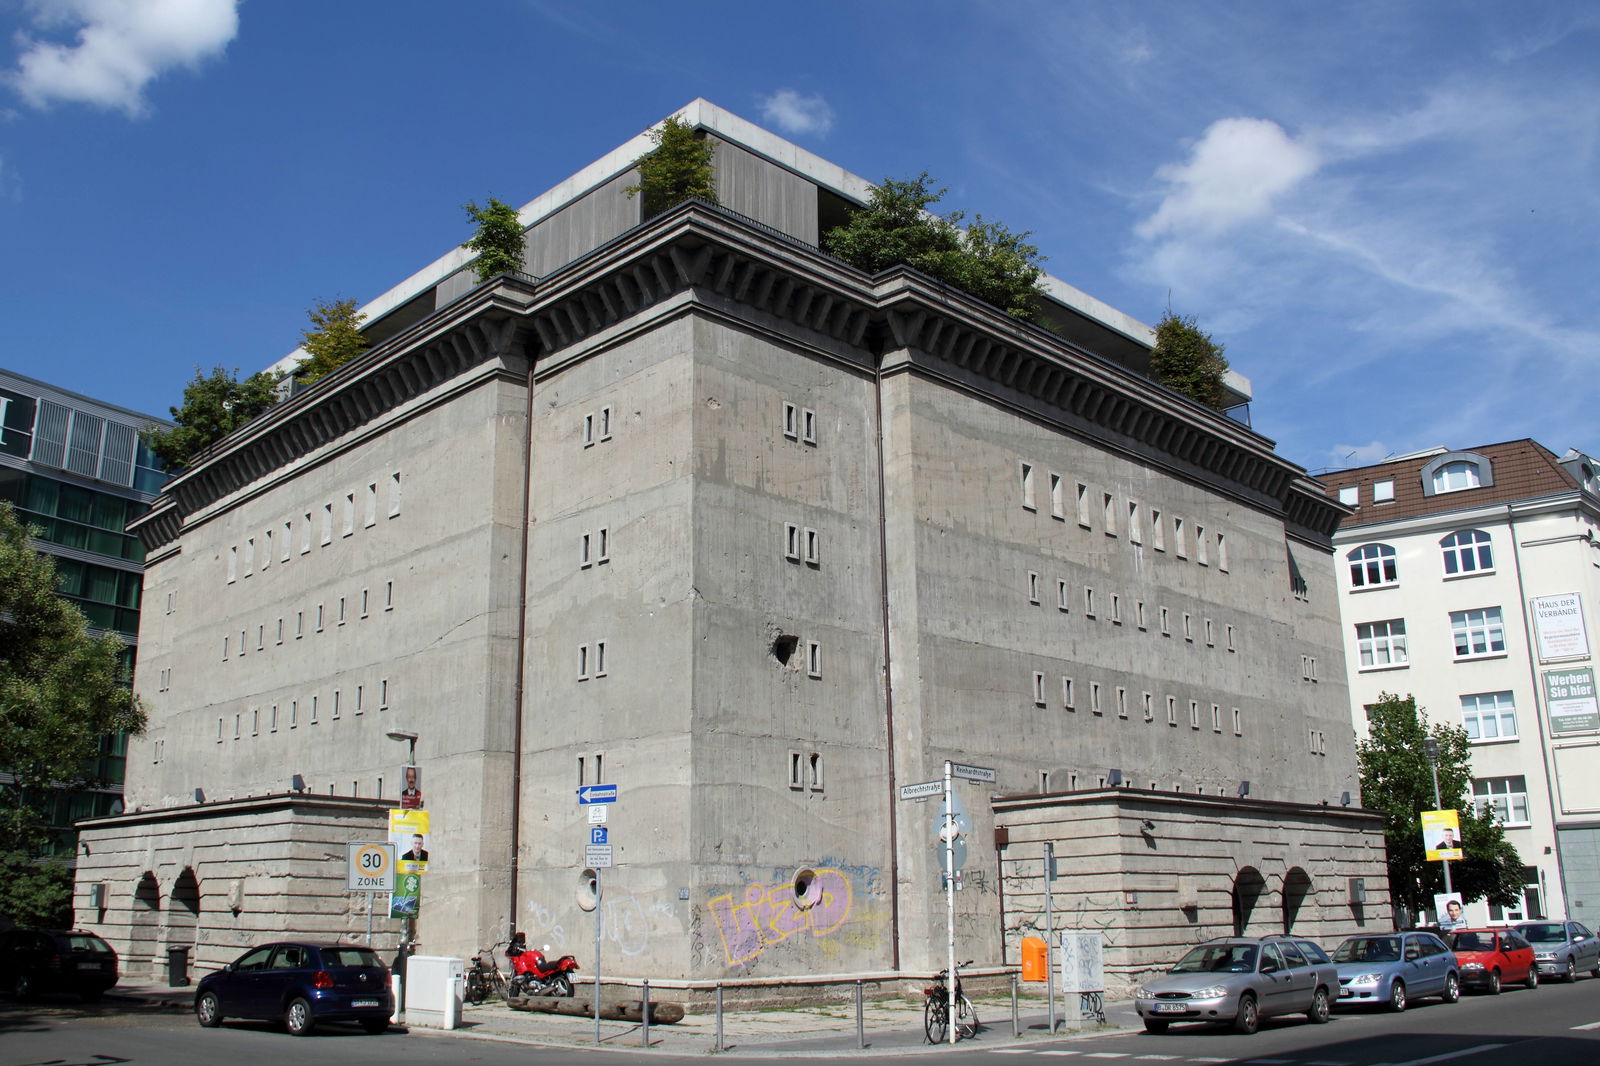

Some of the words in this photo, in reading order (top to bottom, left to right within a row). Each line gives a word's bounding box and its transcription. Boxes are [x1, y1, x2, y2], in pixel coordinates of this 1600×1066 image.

[1538, 601, 1559, 609] HAUS
[1560, 599, 1575, 607] DER
[1548, 673, 1590, 687] Werben
[1550, 687, 1568, 699] Sie
[1570, 684, 1592, 697] hier
[593, 829, 603, 843] P
[362, 853, 382, 868] 30
[357, 877, 385, 887] ZONE
